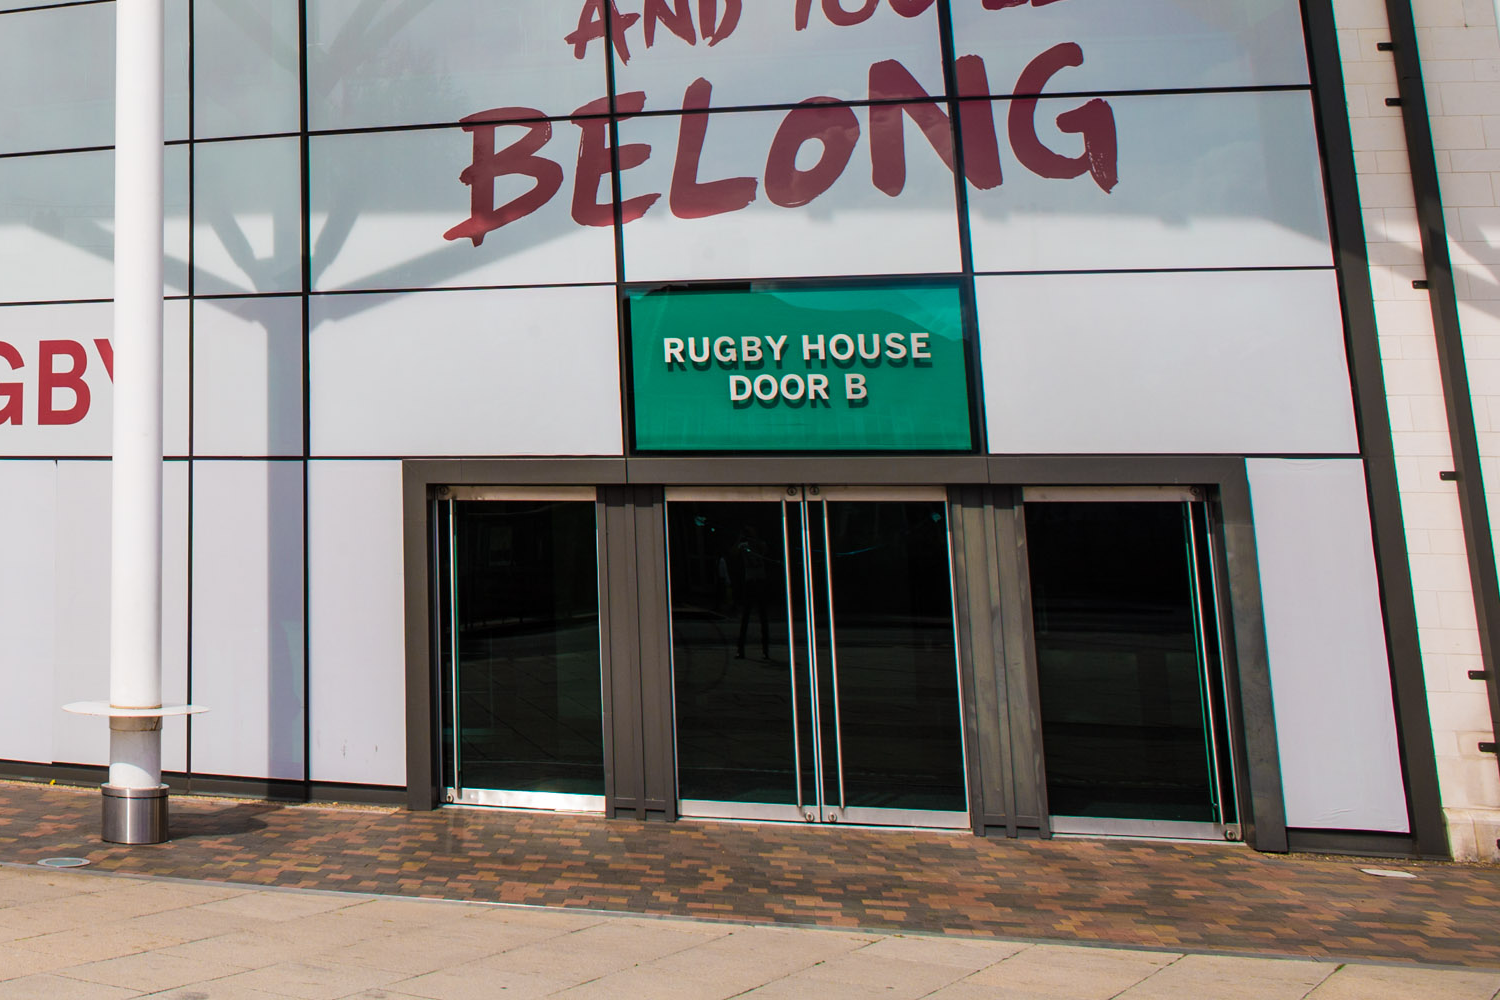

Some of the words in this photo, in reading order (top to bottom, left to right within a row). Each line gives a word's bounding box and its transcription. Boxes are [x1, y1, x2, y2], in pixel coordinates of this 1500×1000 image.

[443, 41, 1118, 248] BELONG
[663, 334, 788, 363] RUGBY
[802, 332, 932, 361] HOUSE
[729, 373, 830, 401] DOOR
[844, 373, 868, 400] B
